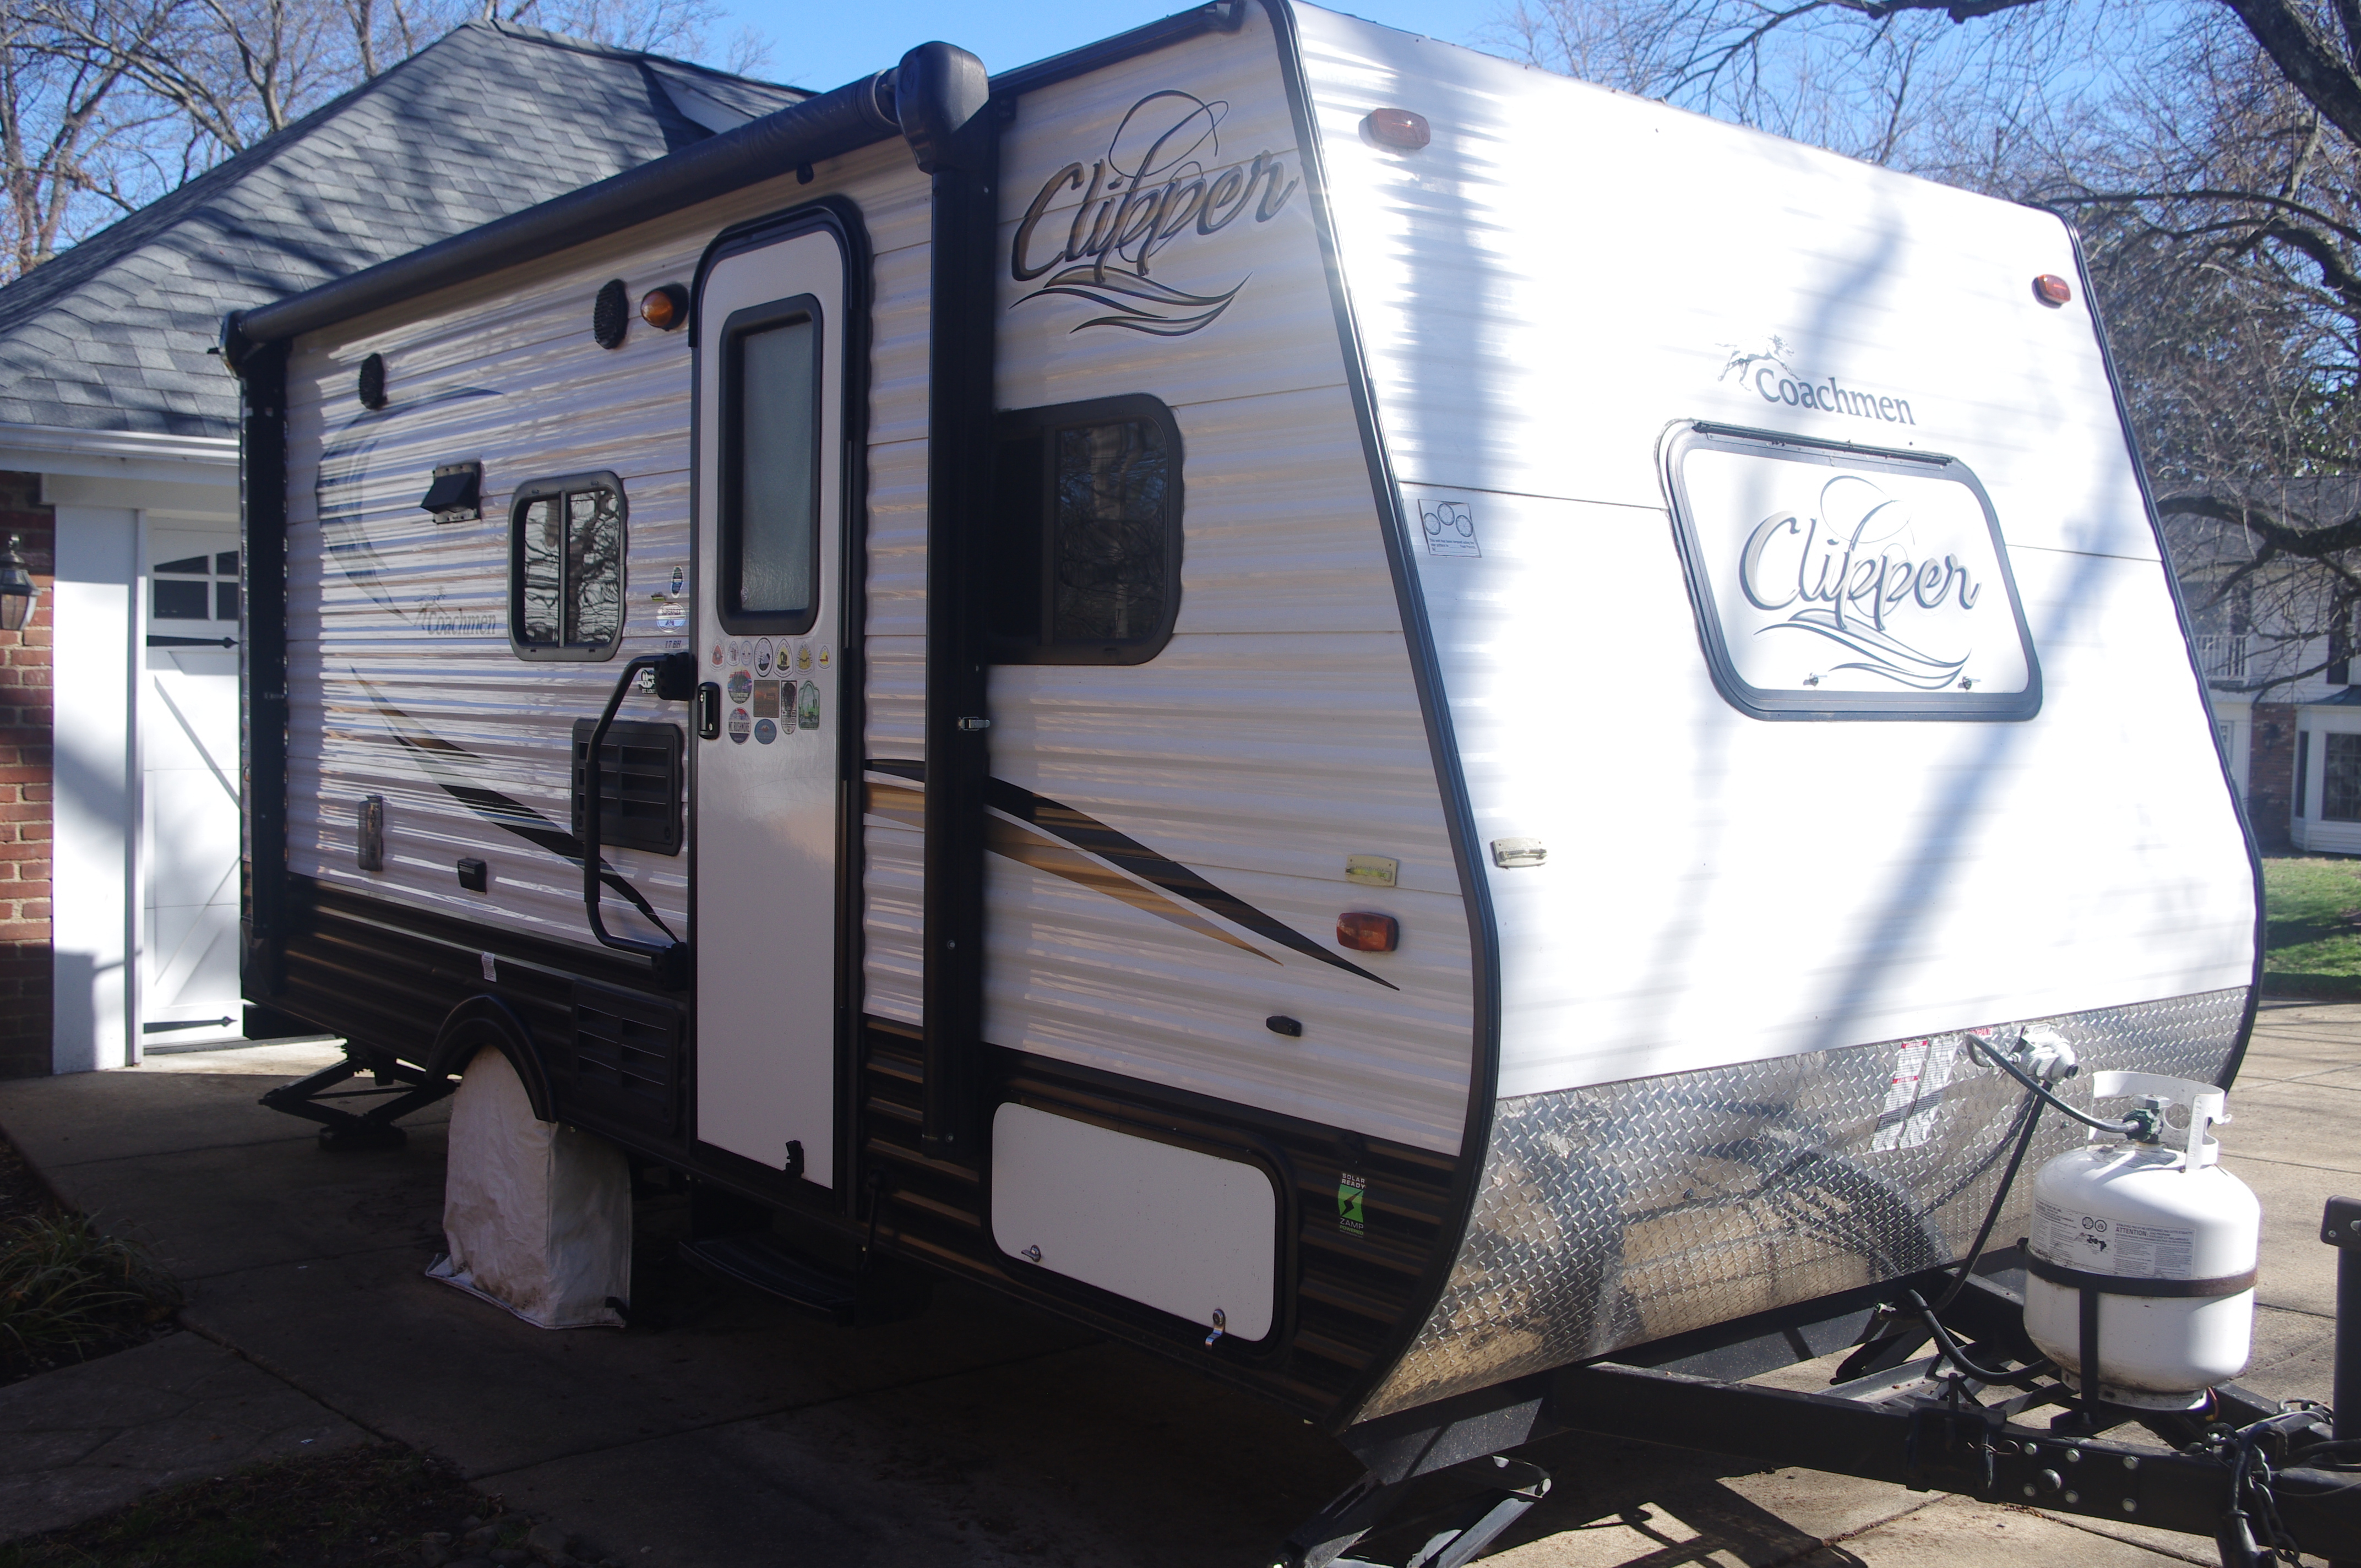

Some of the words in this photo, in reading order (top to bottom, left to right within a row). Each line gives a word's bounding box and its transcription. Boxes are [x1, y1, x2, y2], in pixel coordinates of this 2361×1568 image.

[1011, 90, 1300, 284] Clipper
[1756, 368, 1916, 426] Coachmen
[1739, 476, 1982, 631] Clipper
[428, 608, 496, 635] Coachmen
[665, 640, 672, 649] 17
[672, 640, 682, 648] BH
[733, 722, 750, 732] RUSHMORE
[1341, 1179, 1366, 1189] READY
[1342, 1173, 1365, 1184] SOLAR
[1340, 1218, 1364, 1230] ZAMP
[1340, 1225, 1363, 1235] POWERED
